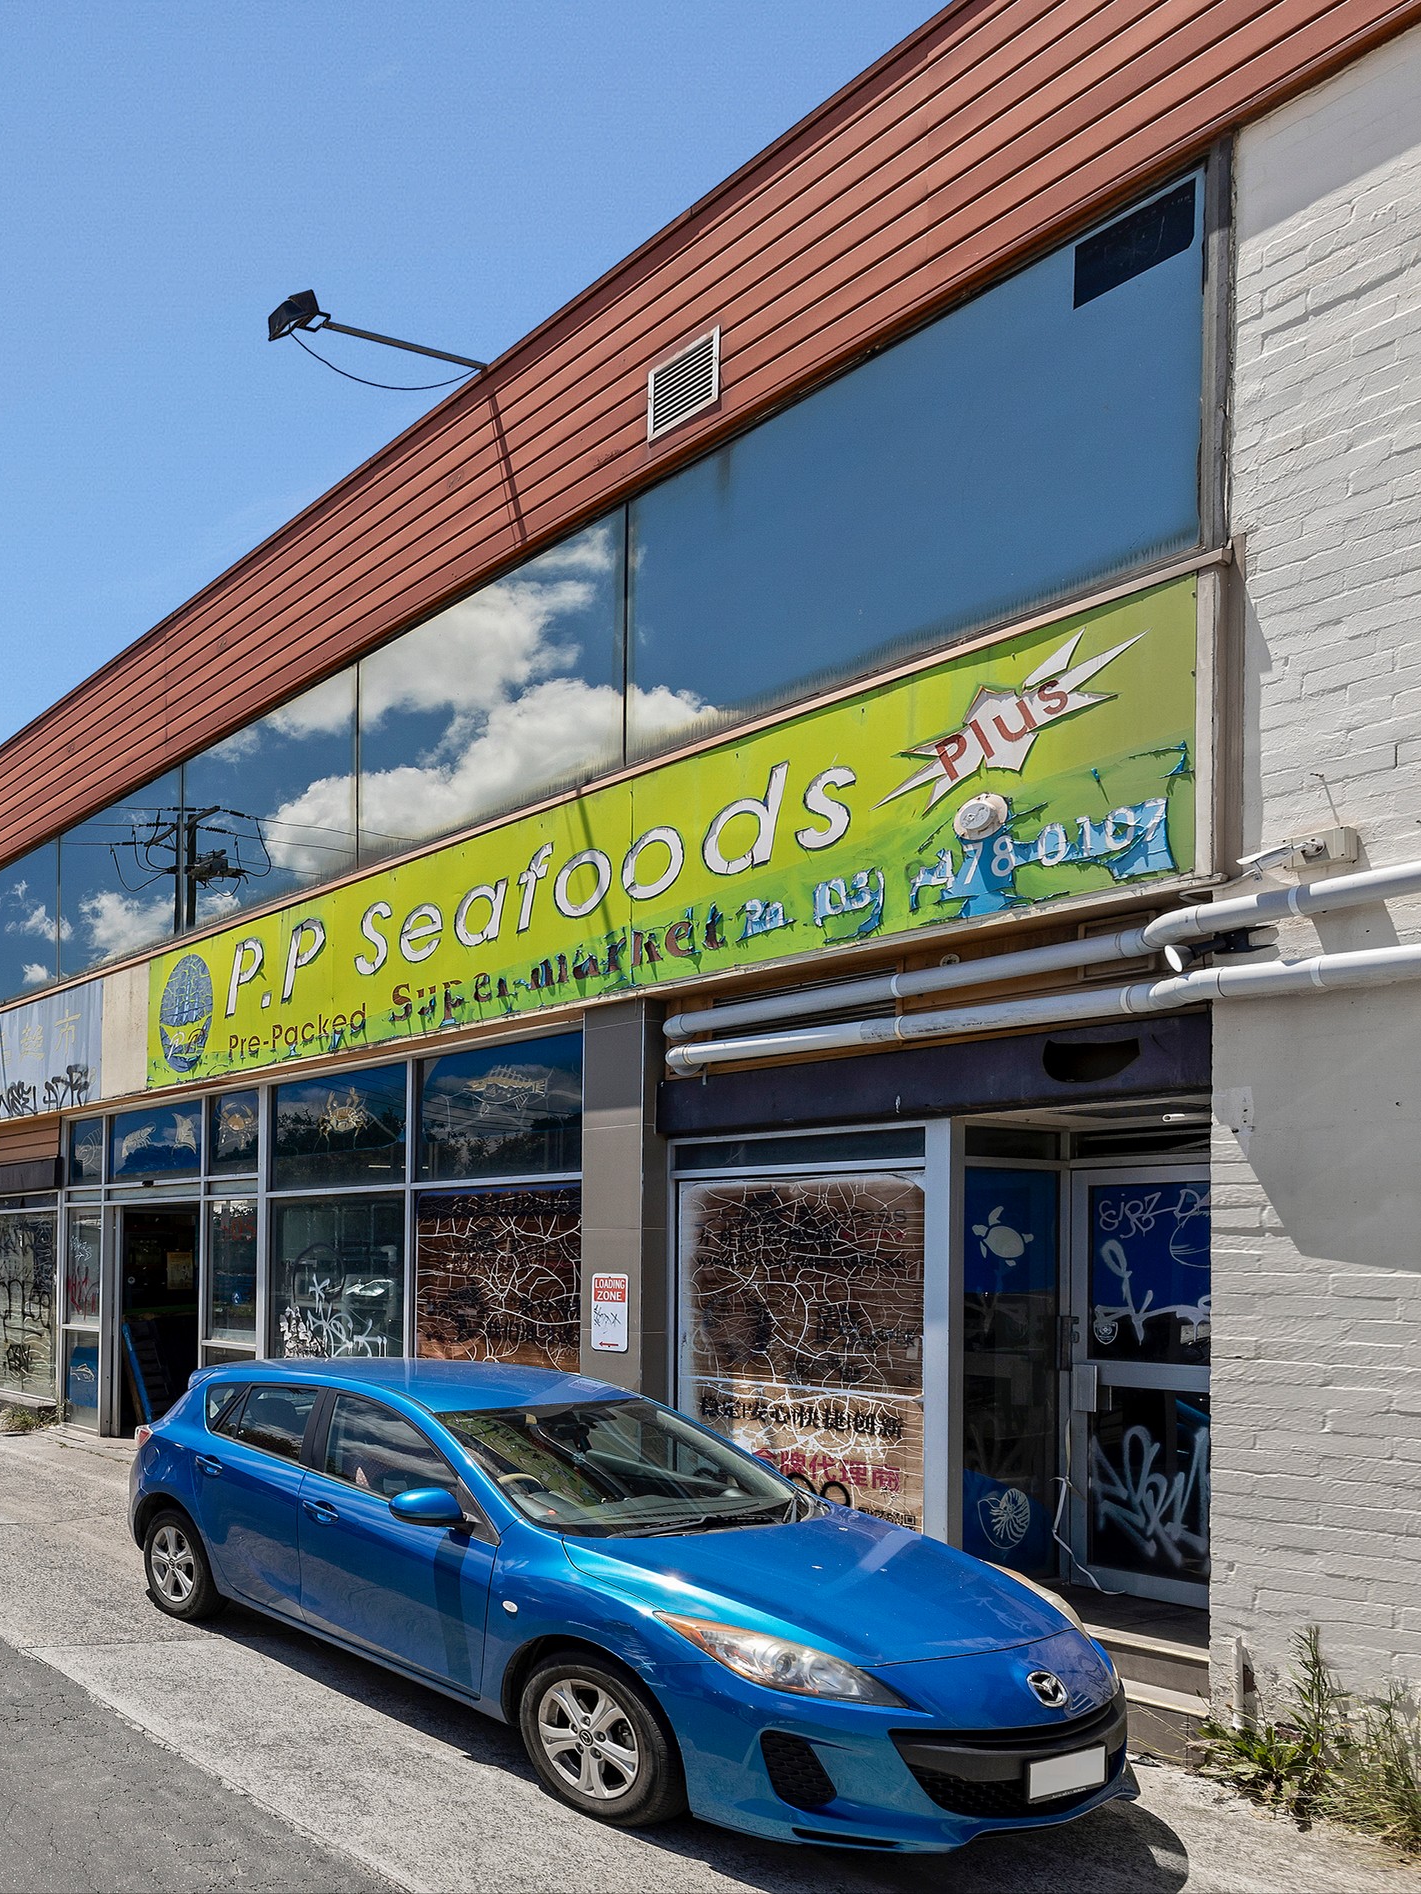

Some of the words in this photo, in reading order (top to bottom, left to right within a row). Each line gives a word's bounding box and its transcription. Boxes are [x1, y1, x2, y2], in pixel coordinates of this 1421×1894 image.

[225, 918, 326, 1018] P.P
[354, 760, 857, 975] Seafoods
[229, 1002, 365, 1060] Pre-Packed
[595, 1279, 626, 1290] LOADING
[597, 1291, 622, 1301] ZONE
